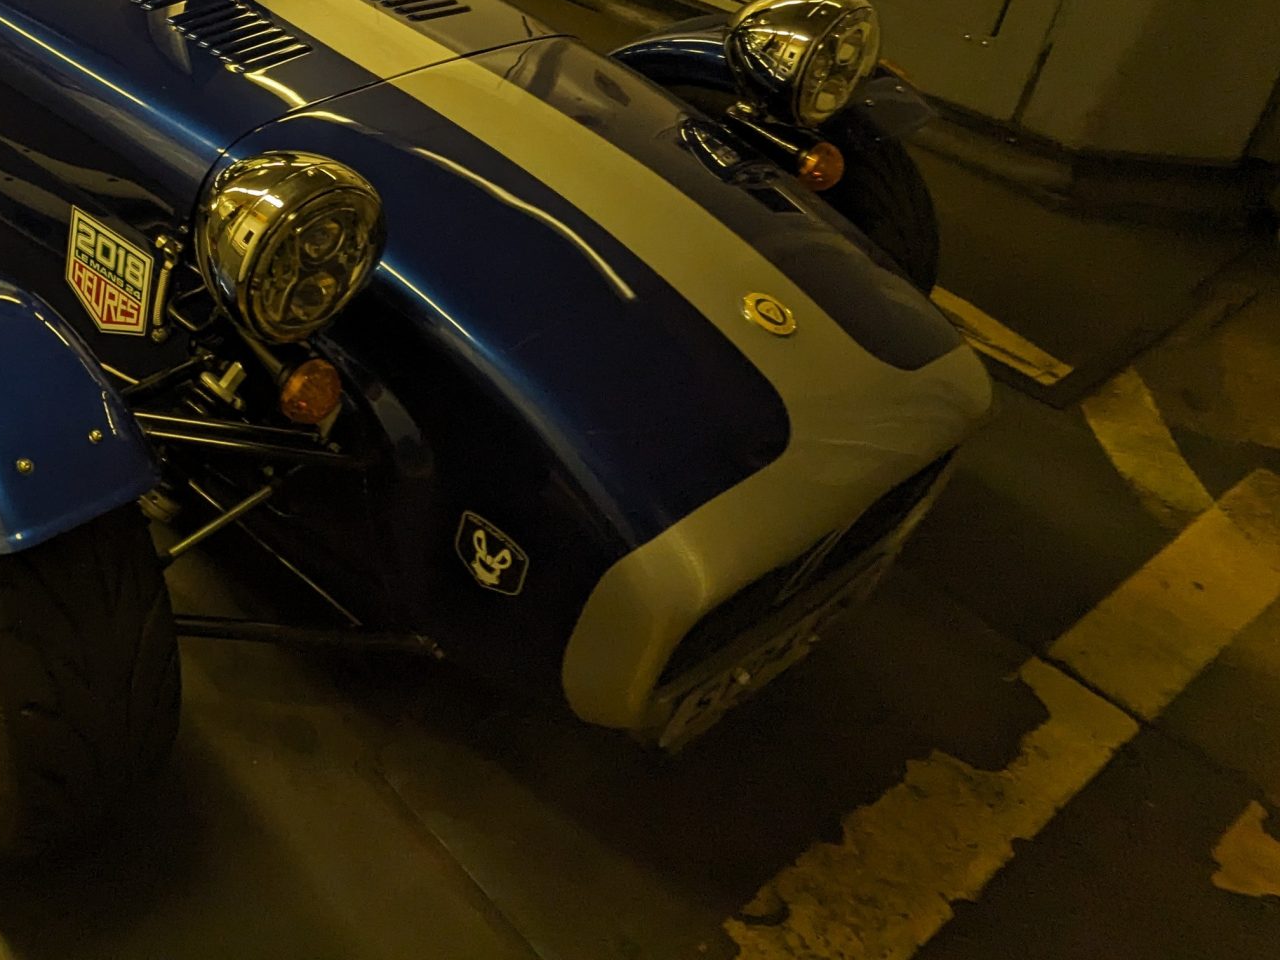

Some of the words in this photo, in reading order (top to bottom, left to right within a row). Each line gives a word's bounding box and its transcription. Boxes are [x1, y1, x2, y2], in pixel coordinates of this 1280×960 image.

[75, 248, 89, 263] LE
[89, 257, 125, 288] MANS
[125, 282, 141, 300] 24
[77, 221, 145, 290] 2018
[74, 262, 140, 323] HEURES
